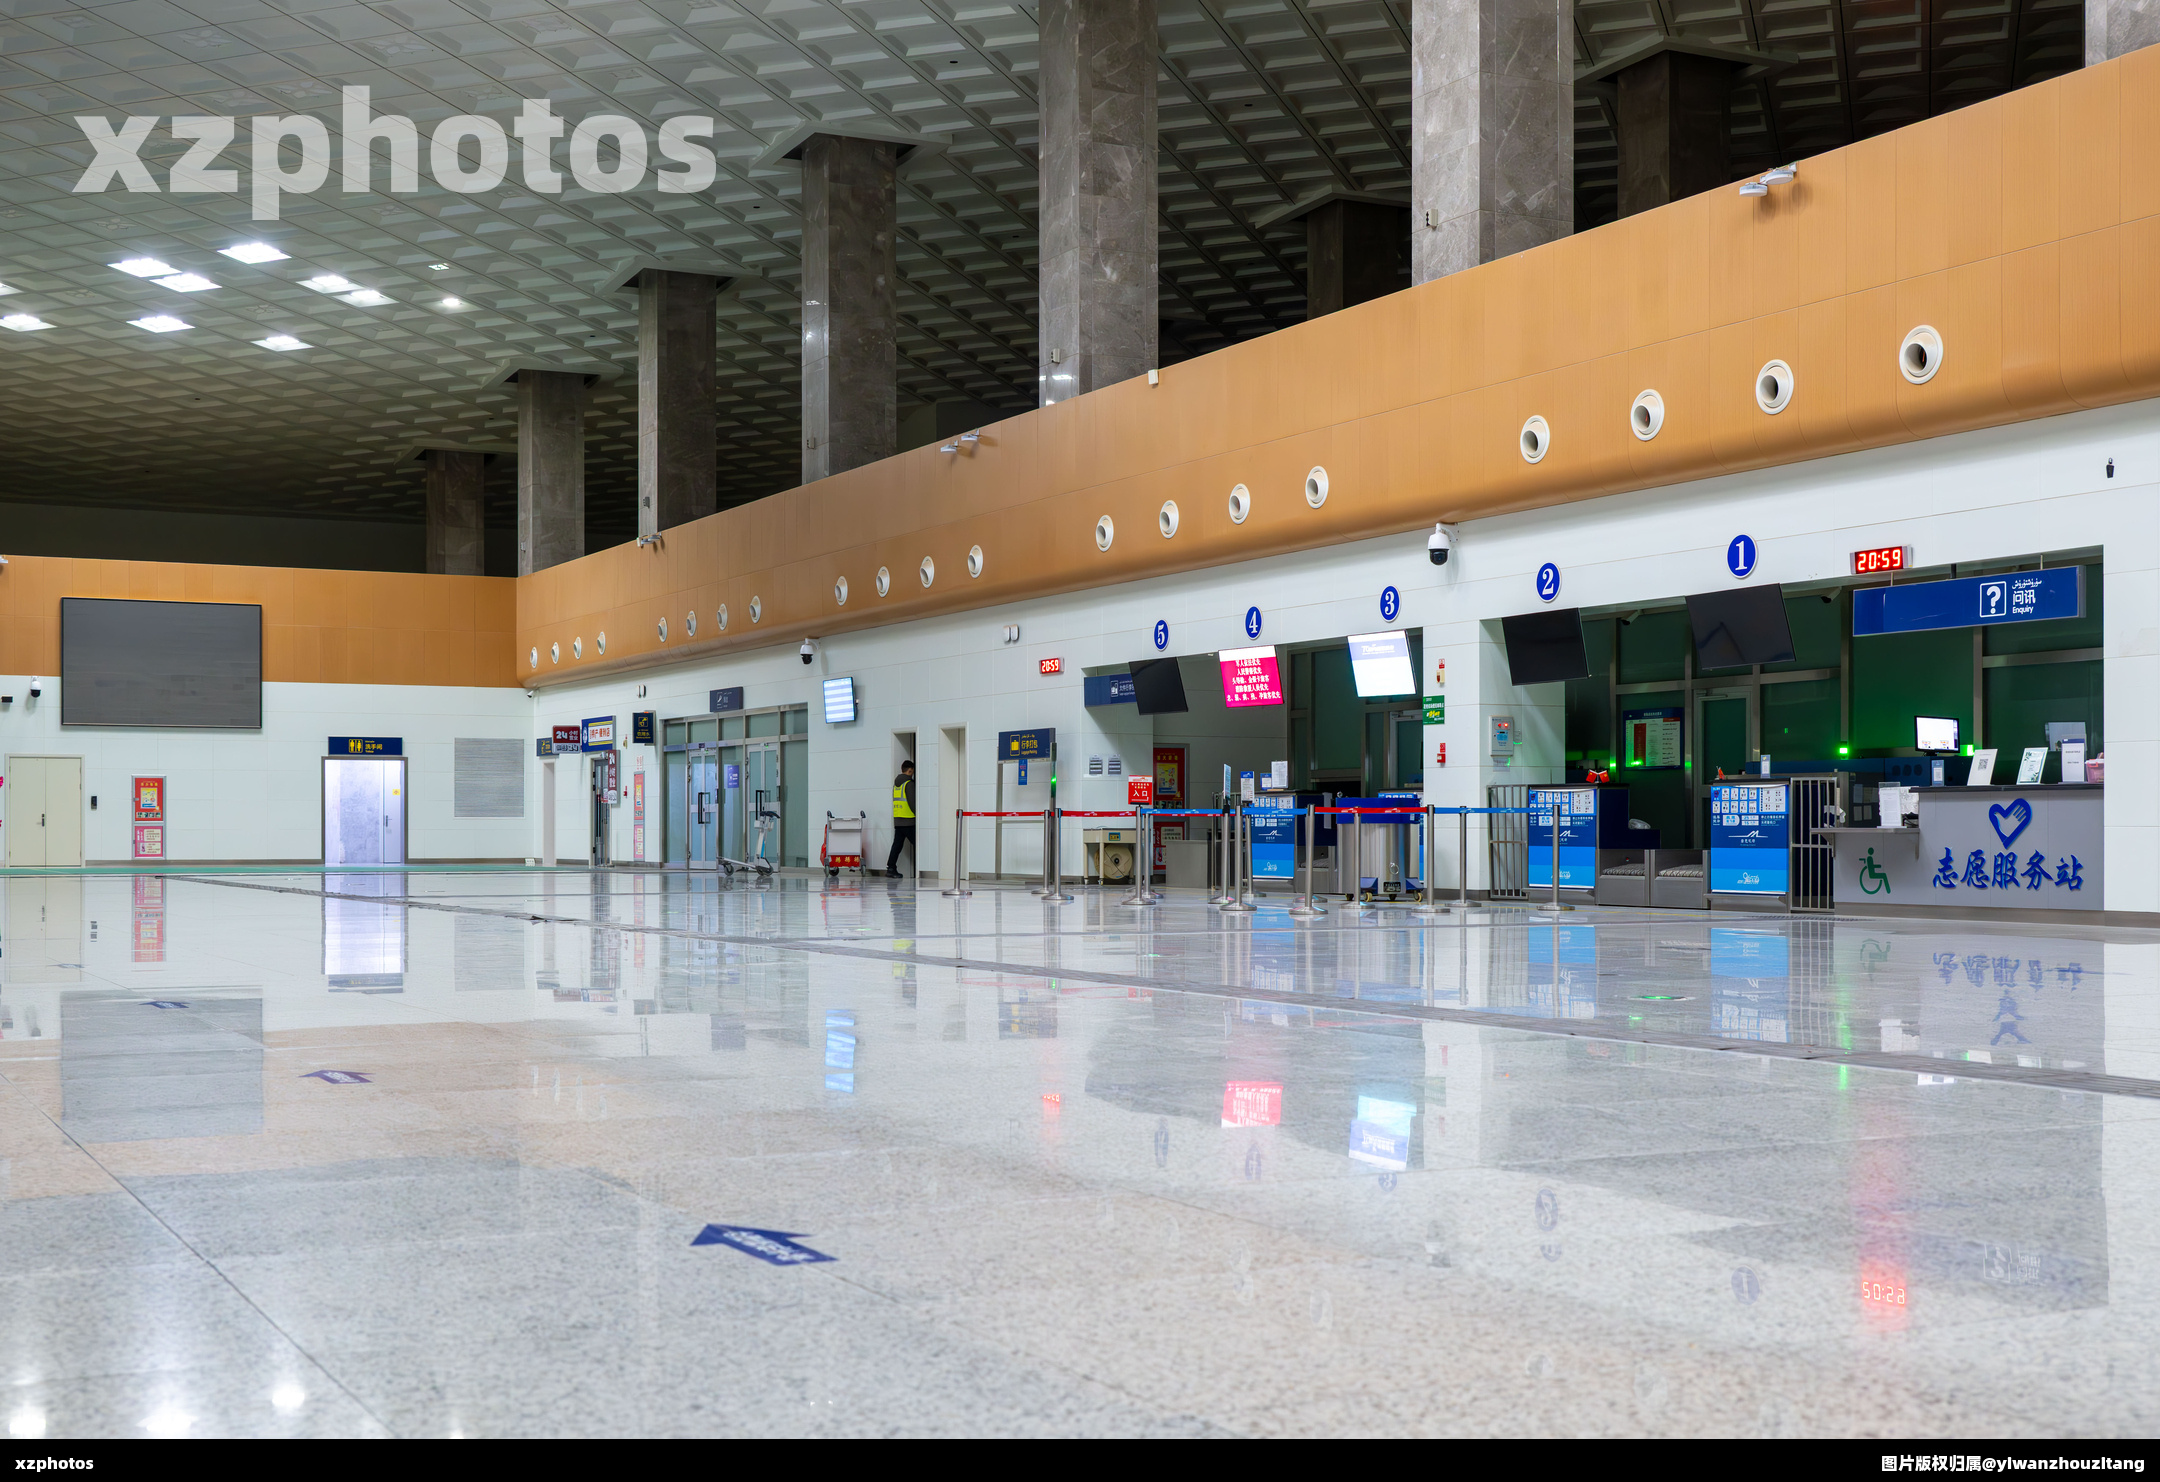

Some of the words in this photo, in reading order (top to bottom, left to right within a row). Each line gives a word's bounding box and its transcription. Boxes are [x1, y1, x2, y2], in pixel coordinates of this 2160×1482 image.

[1735, 540, 1748, 571] 1
[1857, 549, 1901, 571] 20:59
[1542, 568, 1554, 596] 2
[1384, 591, 1395, 616] 3
[2012, 589, 2037, 605] 问讯
[2012, 605, 2034, 614] Enquiry
[1248, 611, 1259, 634] 4
[1157, 624, 1165, 646] 5
[1041, 659, 1059, 672] 20:59
[556, 730, 568, 739] 24
[1932, 847, 2084, 892] 志愿服务站
